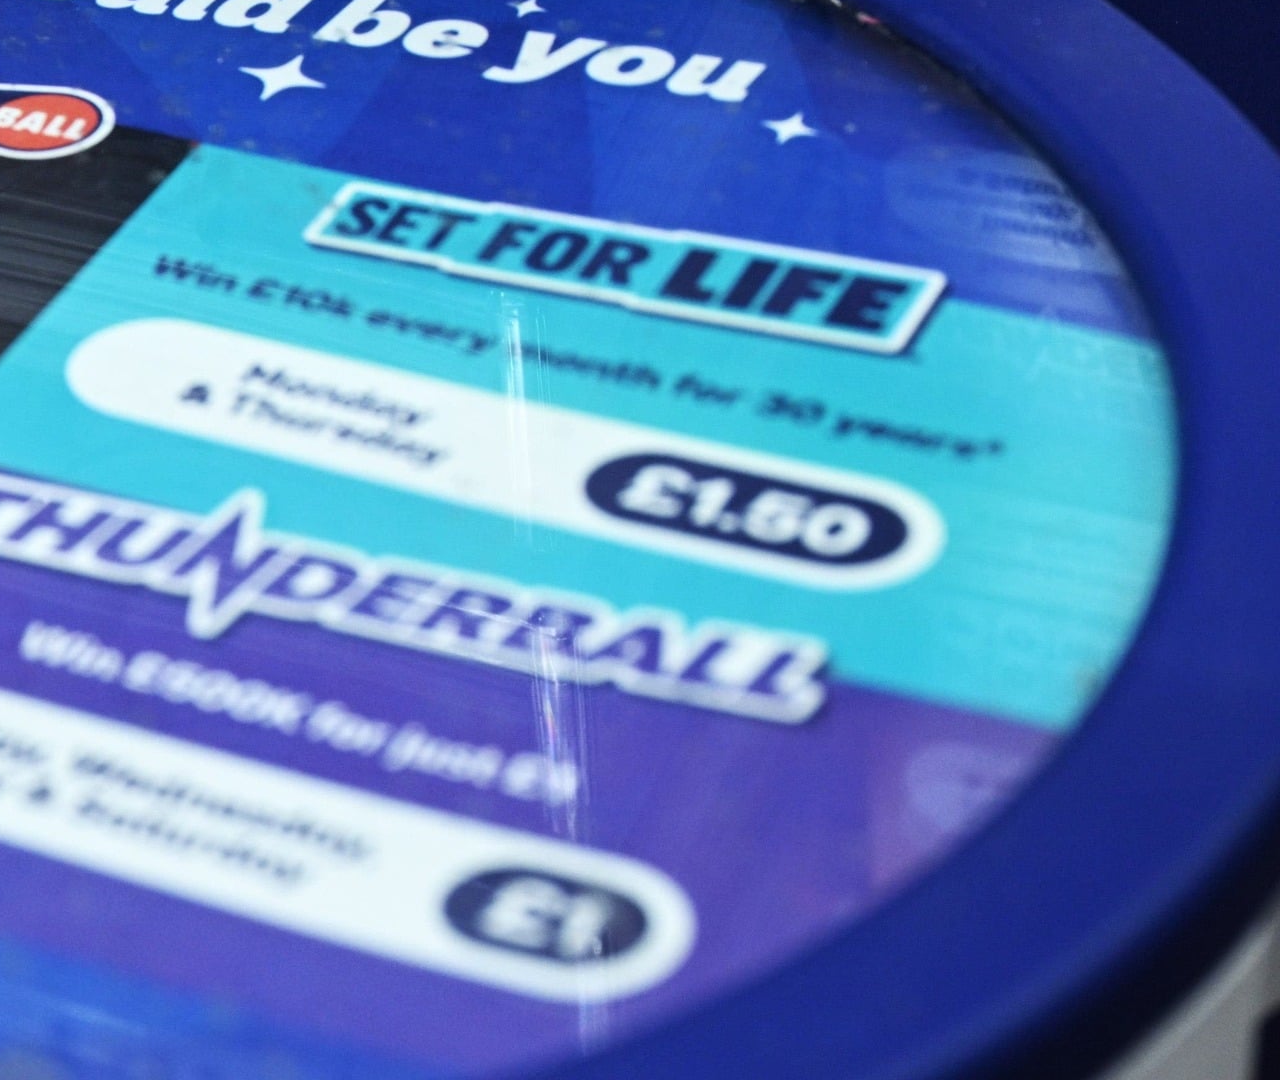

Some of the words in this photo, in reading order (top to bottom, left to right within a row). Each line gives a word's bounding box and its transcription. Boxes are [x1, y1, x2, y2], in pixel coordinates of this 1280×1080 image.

[482, 30, 767, 102] you
[336, 197, 475, 249] SET
[480, 222, 649, 283] FOR
[663, 250, 905, 330] LIFE
[154, 255, 238, 291] Win
[365, 309, 495, 355] every
[511, 343, 662, 391] month
[673, 373, 740, 404] for
[761, 393, 826, 421] 30
[178, 381, 212, 406] &
[231, 392, 446, 467] Thursday
[241, 363, 426, 427] Monday
[618, 461, 873, 557] £1.50
[22, 624, 121, 677] Win
[308, 702, 388, 751] for
[385, 728, 503, 784] just
[478, 875, 610, 958] £1
